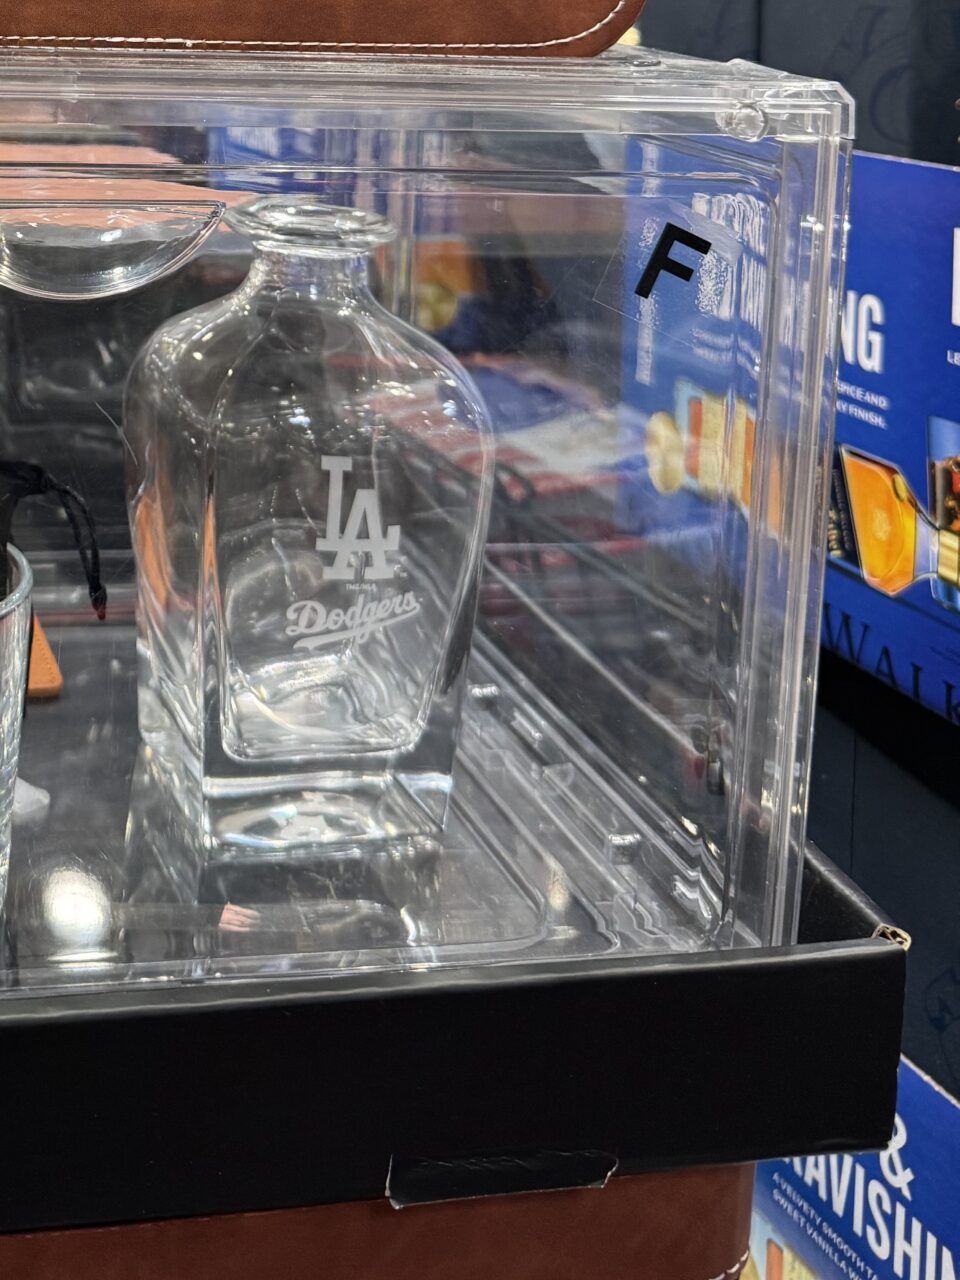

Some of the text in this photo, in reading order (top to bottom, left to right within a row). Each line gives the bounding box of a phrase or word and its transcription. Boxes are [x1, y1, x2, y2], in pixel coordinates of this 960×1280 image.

[635, 222, 711, 299] F
[315, 455, 401, 579] LA
[285, 591, 421, 650] Dodgers
